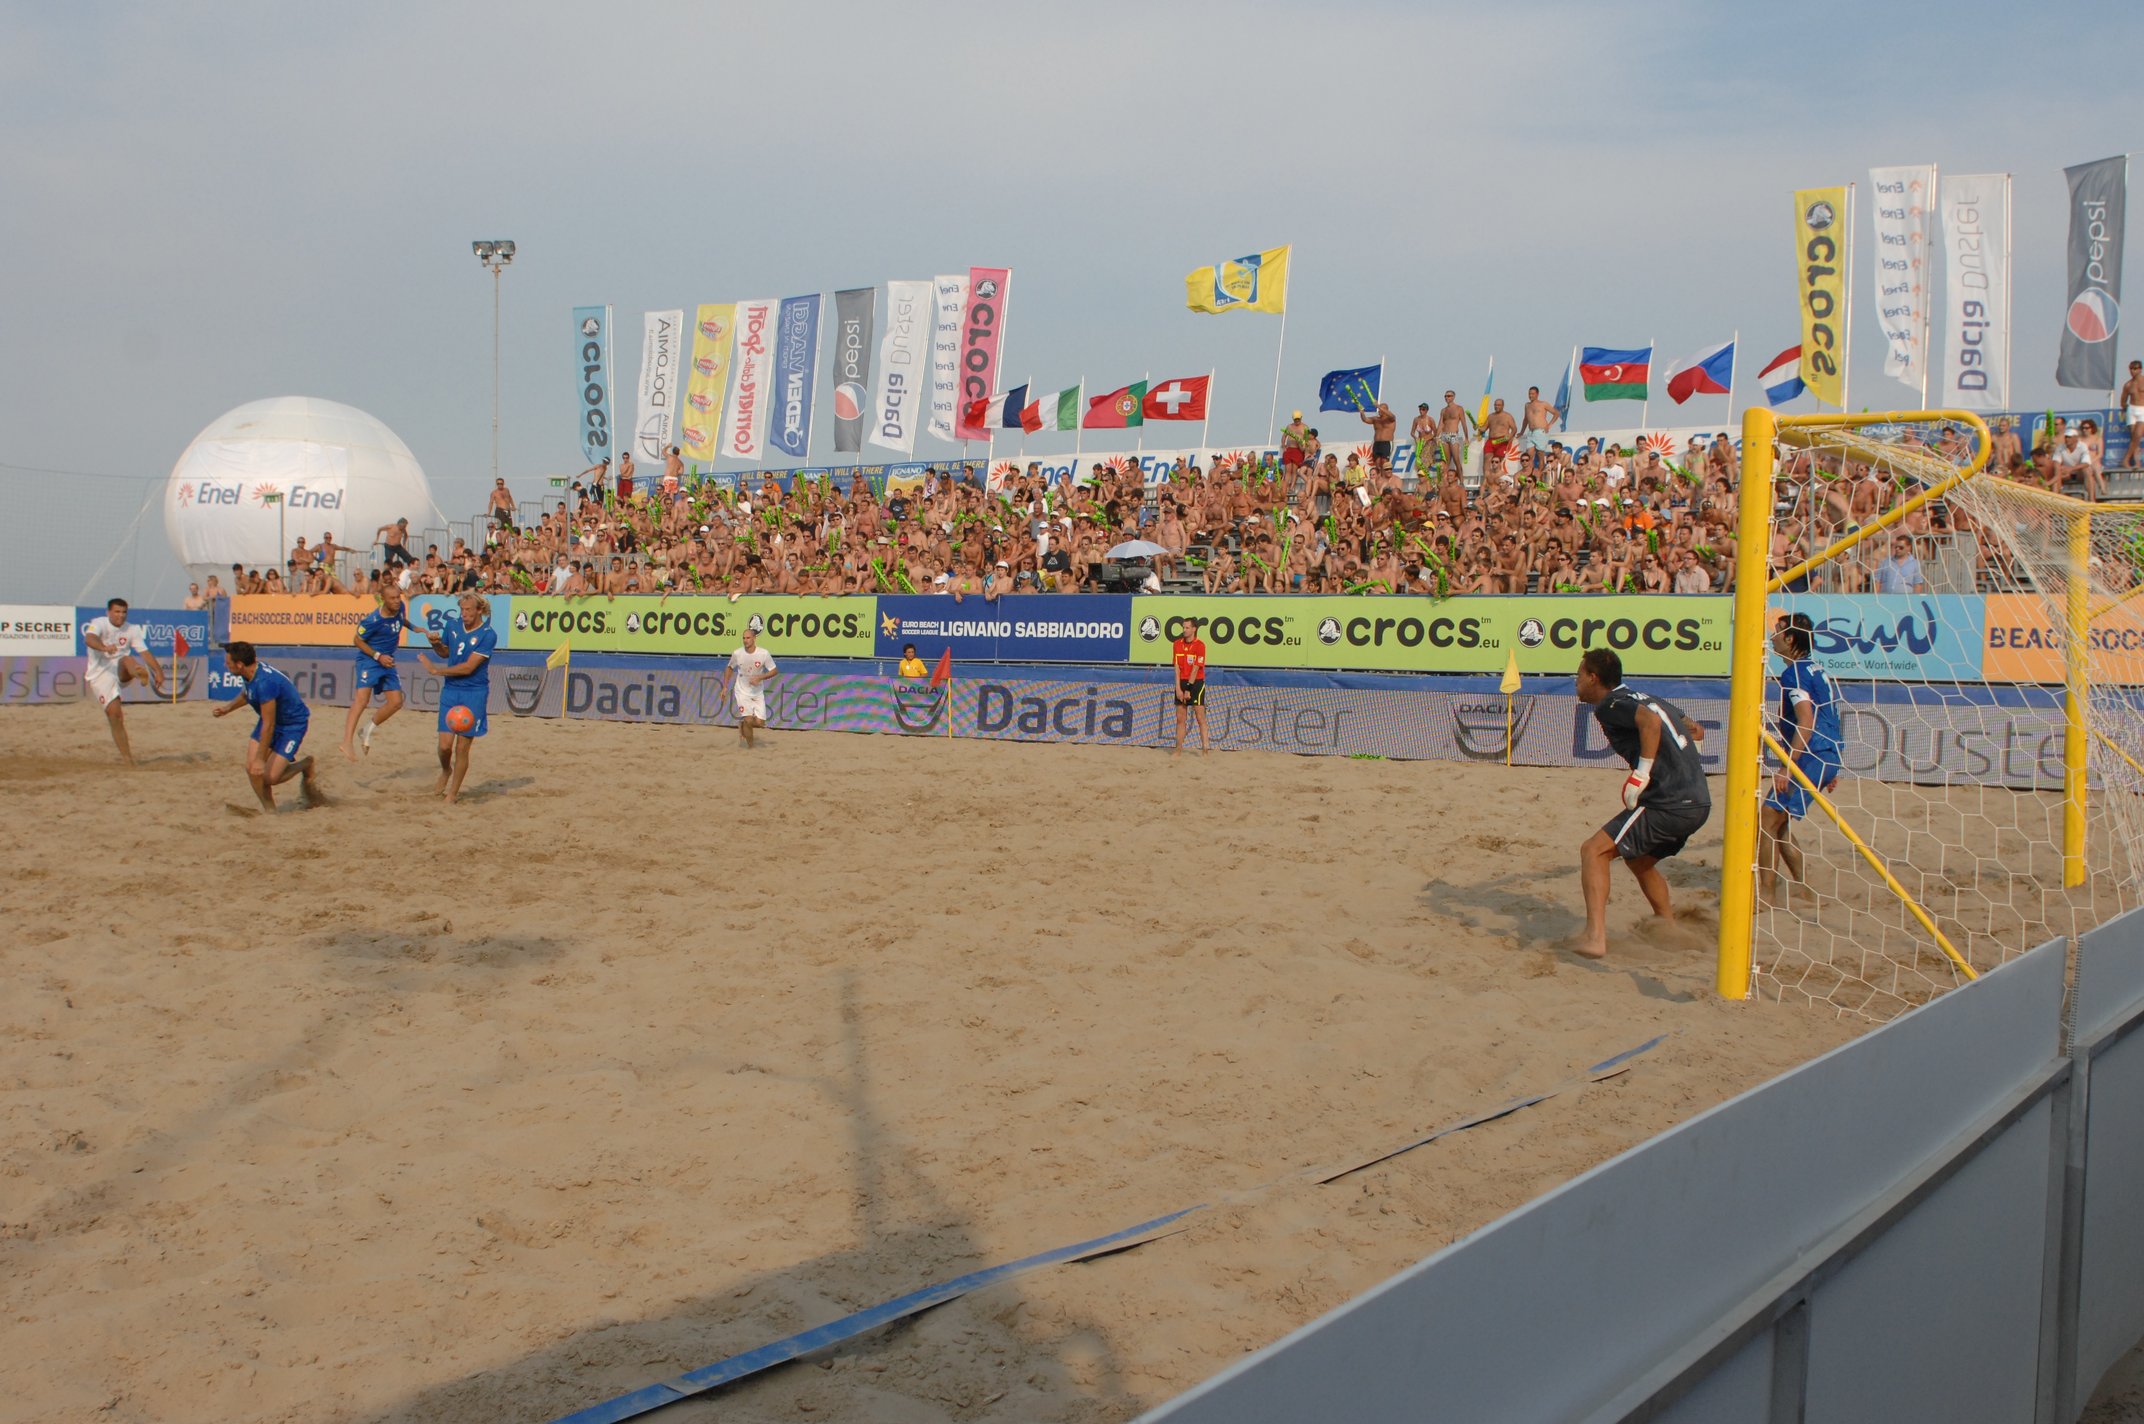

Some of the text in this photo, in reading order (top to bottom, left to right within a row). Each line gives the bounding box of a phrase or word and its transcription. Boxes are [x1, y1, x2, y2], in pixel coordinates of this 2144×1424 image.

[2083, 201, 2110, 284] pepsi
[844, 320, 862, 379] pepsi
[198, 482, 243, 505] Enel
[288, 485, 343, 510] Enel
[231, 612, 313, 625] BEACHSOCCER.COM
[902, 621, 940, 629] EURO BEACH
[15, 622, 71, 633] SECRET
[940, 621, 1123, 639] LIGNANO SABBIADORO
[457, 642, 465, 655] 2
[1864, 659, 1918, 671] Worldwide
[509, 673, 540, 682] DACIA
[566, 672, 681, 717] Dacia
[898, 685, 939, 695] DACIA
[976, 684, 1134, 738] Dacia
[1646, 702, 1688, 750] 1
[285, 740, 295, 754] 6
